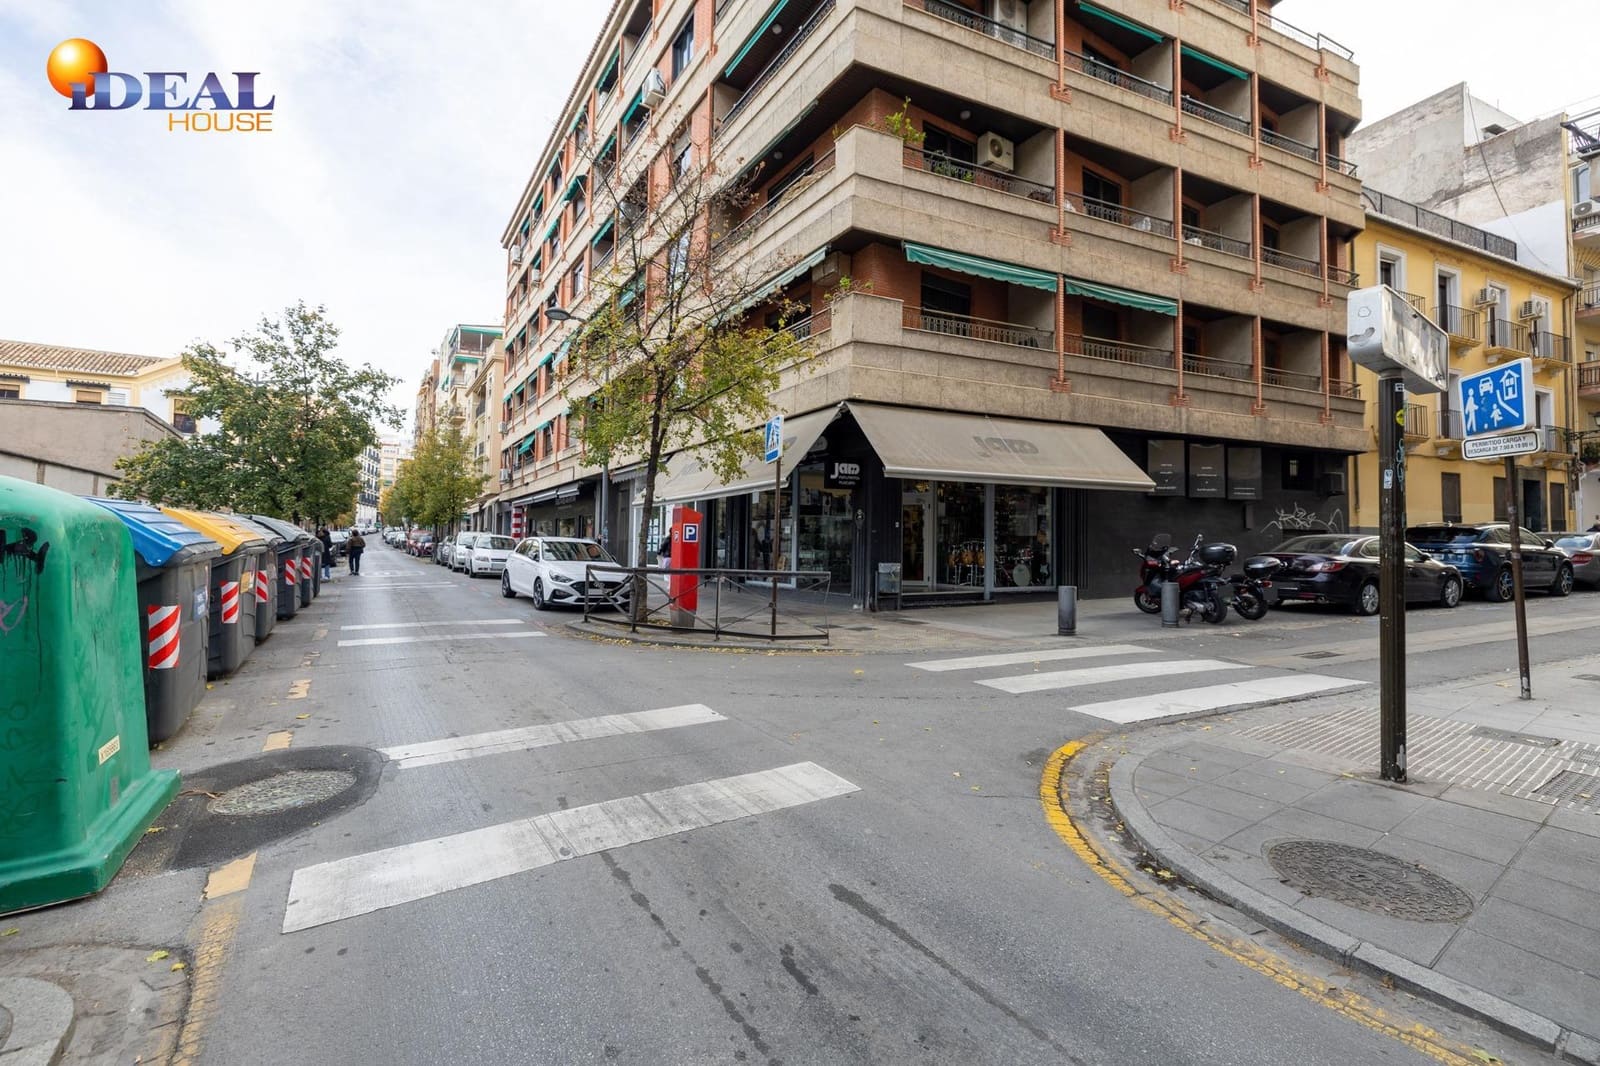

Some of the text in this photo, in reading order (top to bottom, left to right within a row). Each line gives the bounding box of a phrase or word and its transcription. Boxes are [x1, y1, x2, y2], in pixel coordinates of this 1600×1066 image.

[1472, 439, 1502, 448] PERMITIDO
[1502, 436, 1522, 445] CARGA
[685, 526, 696, 540] P
